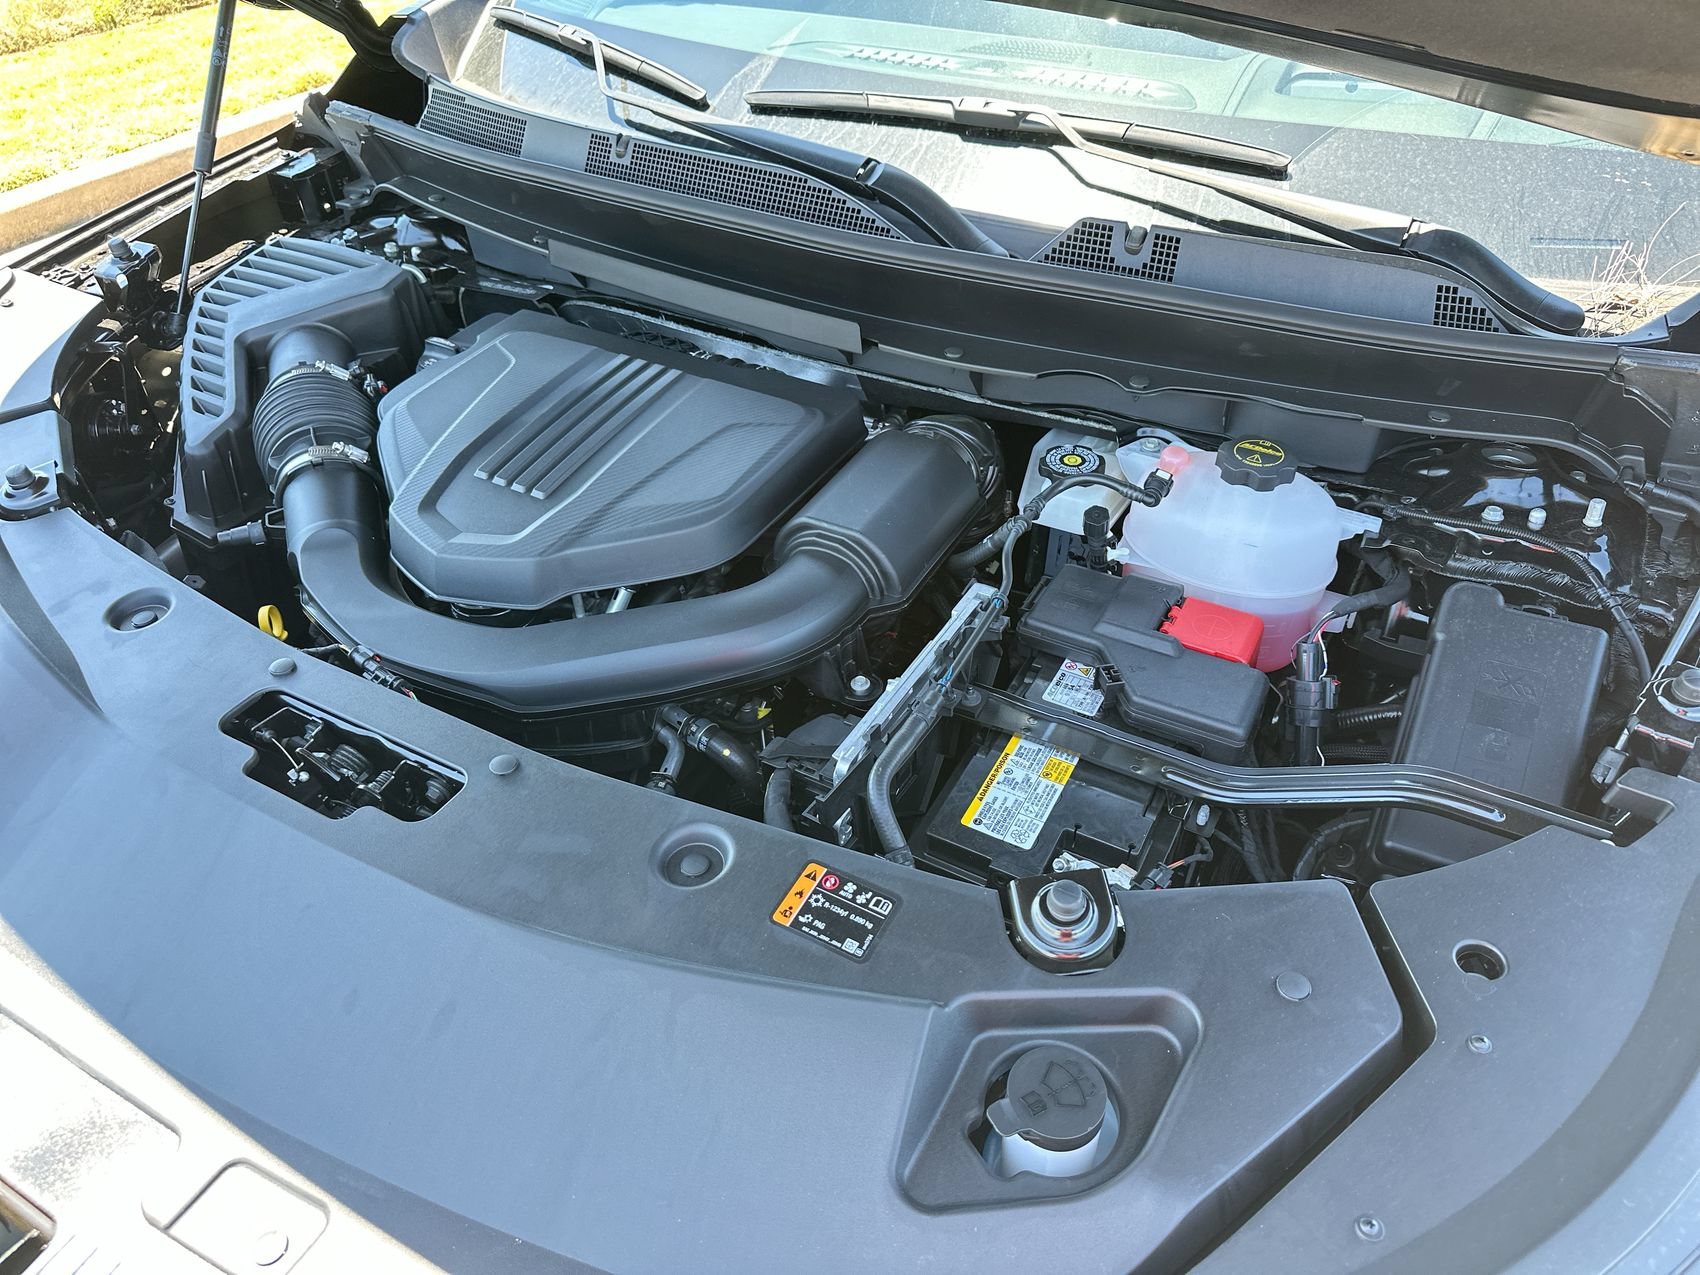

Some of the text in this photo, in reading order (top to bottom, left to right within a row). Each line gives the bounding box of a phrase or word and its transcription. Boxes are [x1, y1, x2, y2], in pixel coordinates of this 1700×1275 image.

[979, 752, 1009, 796] DANGER/POISON
[839, 890, 853, 899] AUTO
[812, 919, 826, 930] PAG
